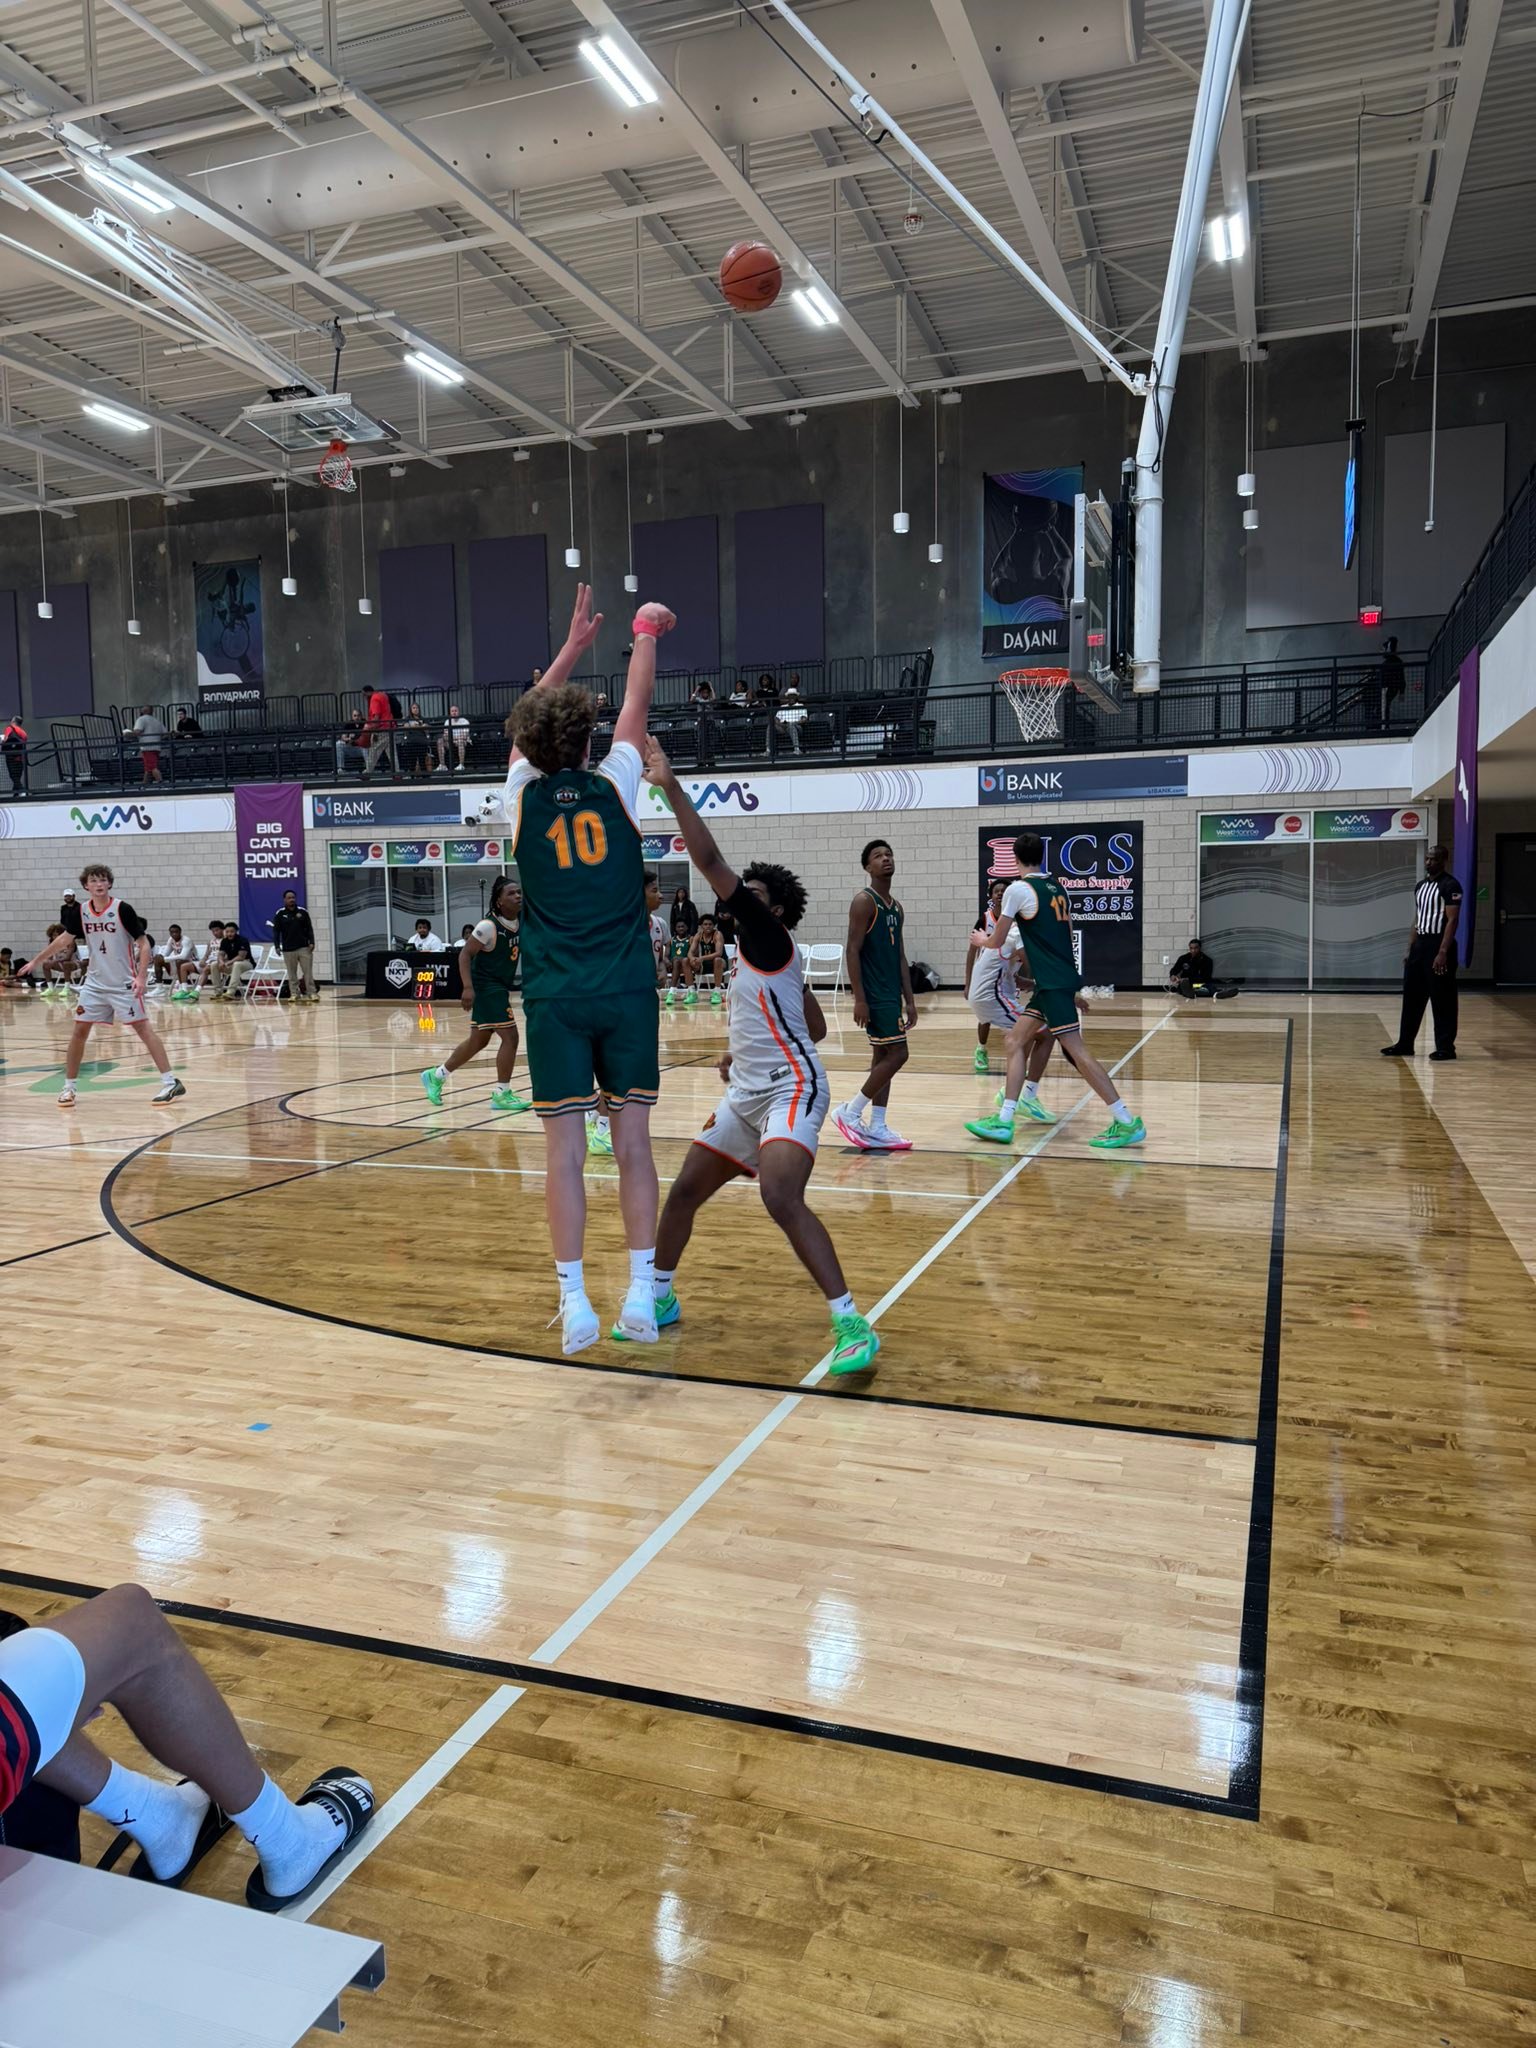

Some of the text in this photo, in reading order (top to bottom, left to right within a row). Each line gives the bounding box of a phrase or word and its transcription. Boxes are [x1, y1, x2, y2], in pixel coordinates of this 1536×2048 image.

[1003, 626, 1057, 653] DASANI
[203, 690, 260, 704] BODYARMOR
[1007, 772, 1063, 791] BANK
[1007, 791, 1063, 801] Be Uncomplicated
[333, 801, 375, 816] BANK
[256, 822, 283, 834] BIG
[250, 837, 291, 849] CATS
[545, 809, 609, 869] 10
[244, 852, 293, 864] DON'T
[244, 866, 298, 879] FLINCH
[1058, 876, 1088, 888] Data
[1088, 875, 1133, 890] Supply
[85, 922, 117, 934] FHG
[99, 940, 107, 954] 4
[388, 968, 409, 976] NXT
[128, 1006, 135, 1017] 4
